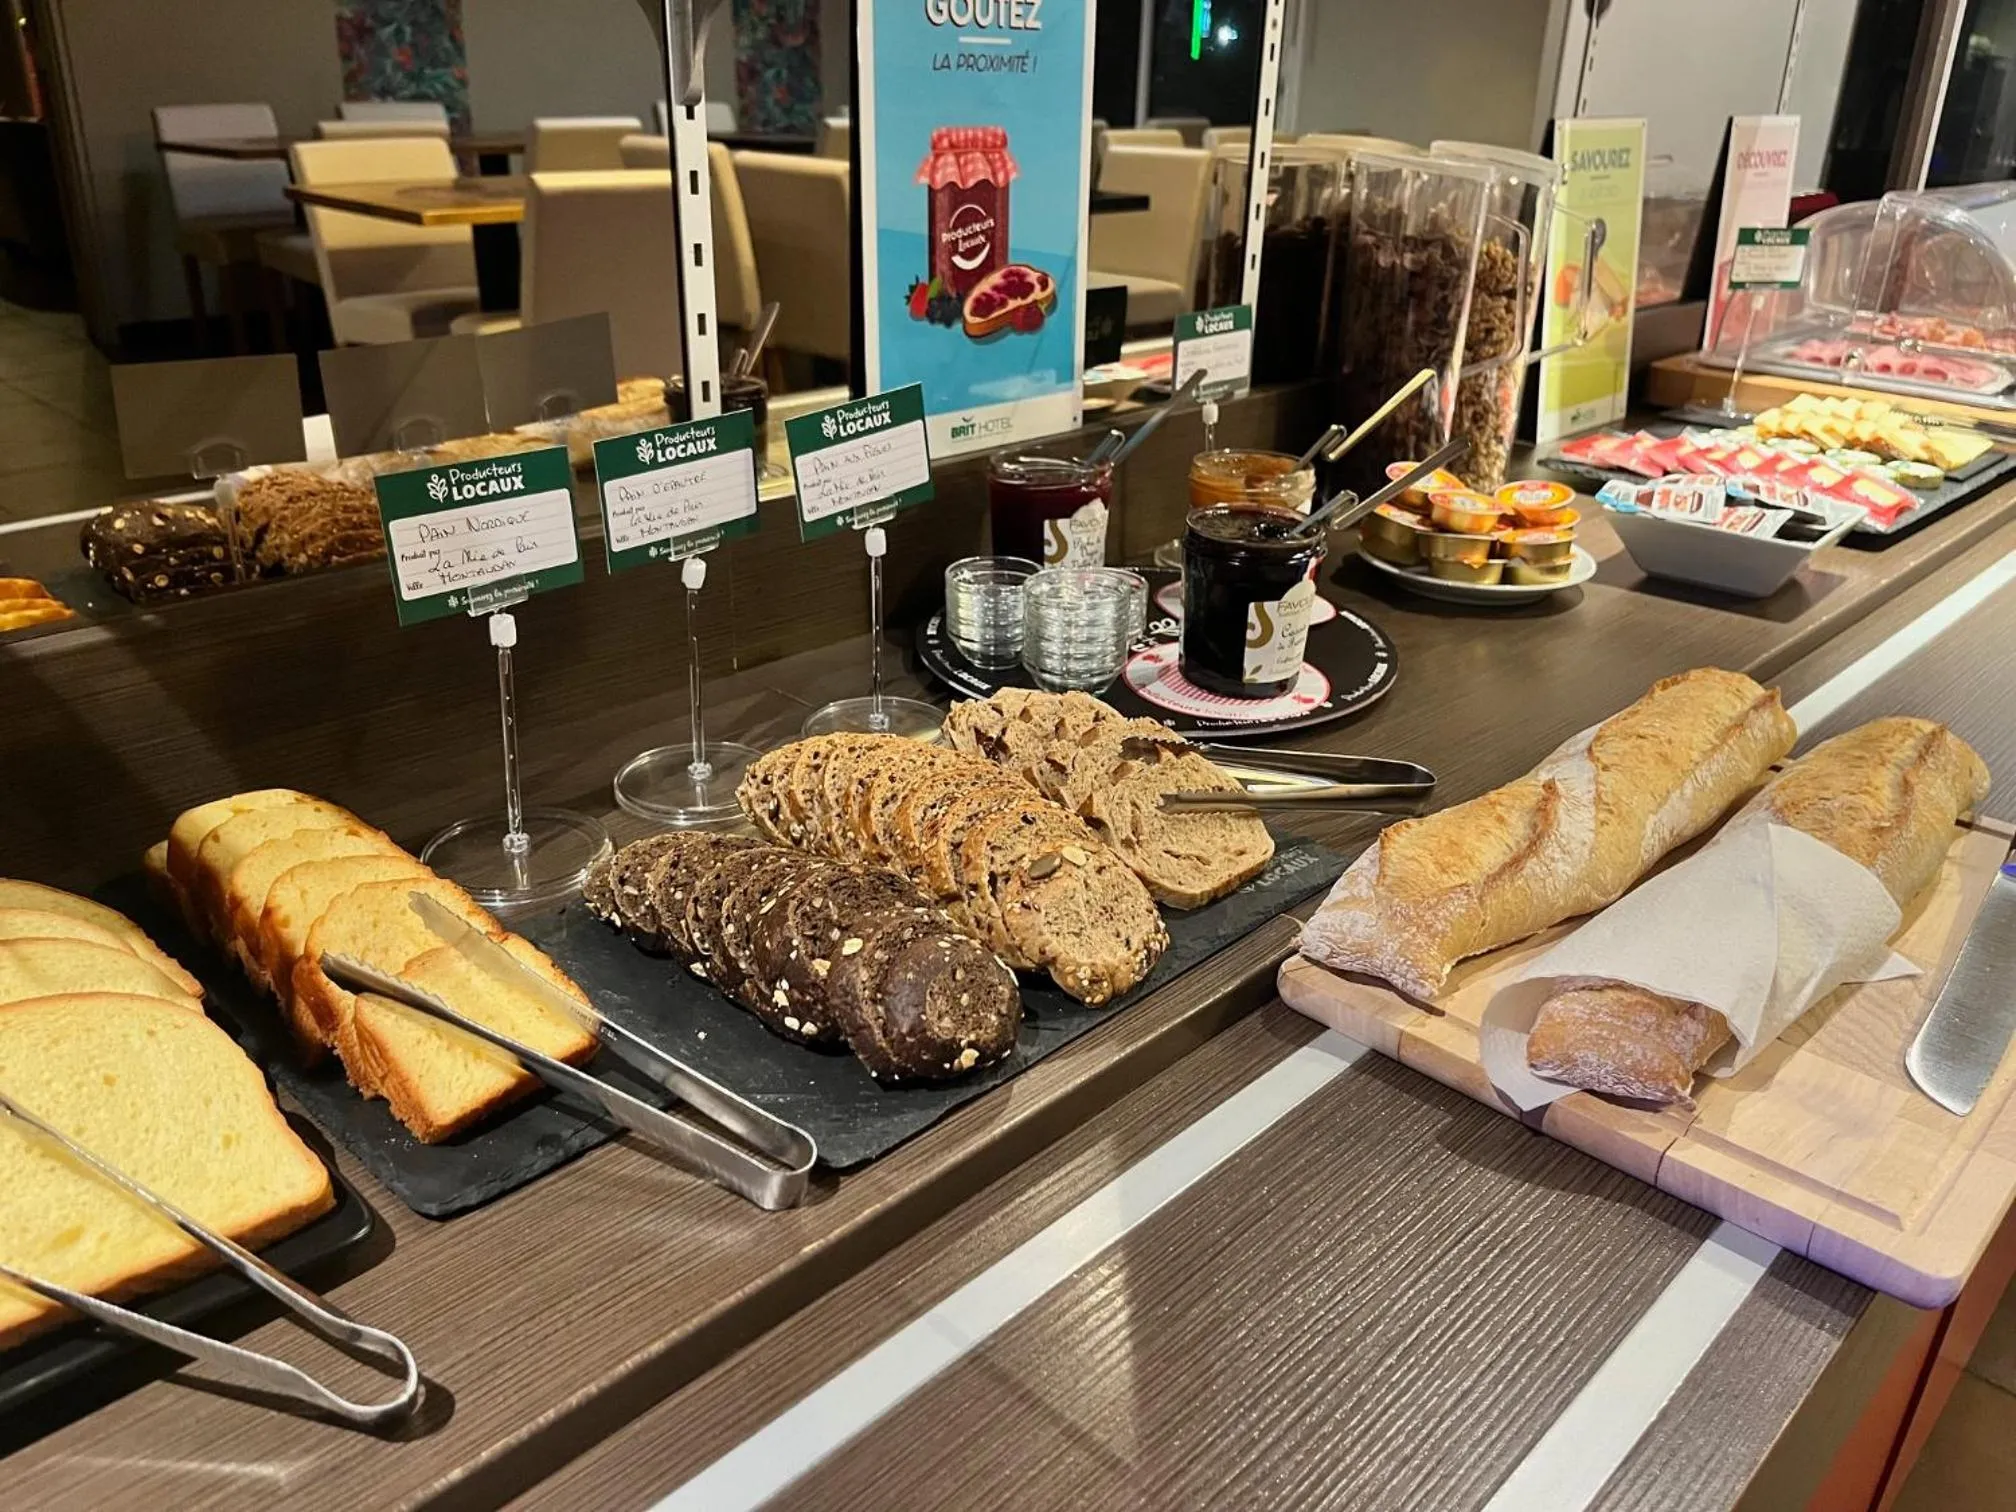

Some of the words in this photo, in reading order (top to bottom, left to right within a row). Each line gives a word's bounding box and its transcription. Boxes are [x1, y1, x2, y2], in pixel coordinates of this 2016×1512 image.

[932, 53, 951, 71] LA
[956, 49, 1030, 73] PROXIMITÉ
[837, 400, 890, 423] Producteurs
[839, 411, 892, 437] LOCAUX
[951, 423, 976, 438] BRIT
[979, 417, 1013, 433] HOTEL
[655, 426, 715, 447] Producteurs
[656, 437, 717, 463] LOCAUX
[449, 462, 522, 484] Producteurs
[452, 475, 525, 501] LOCAUX
